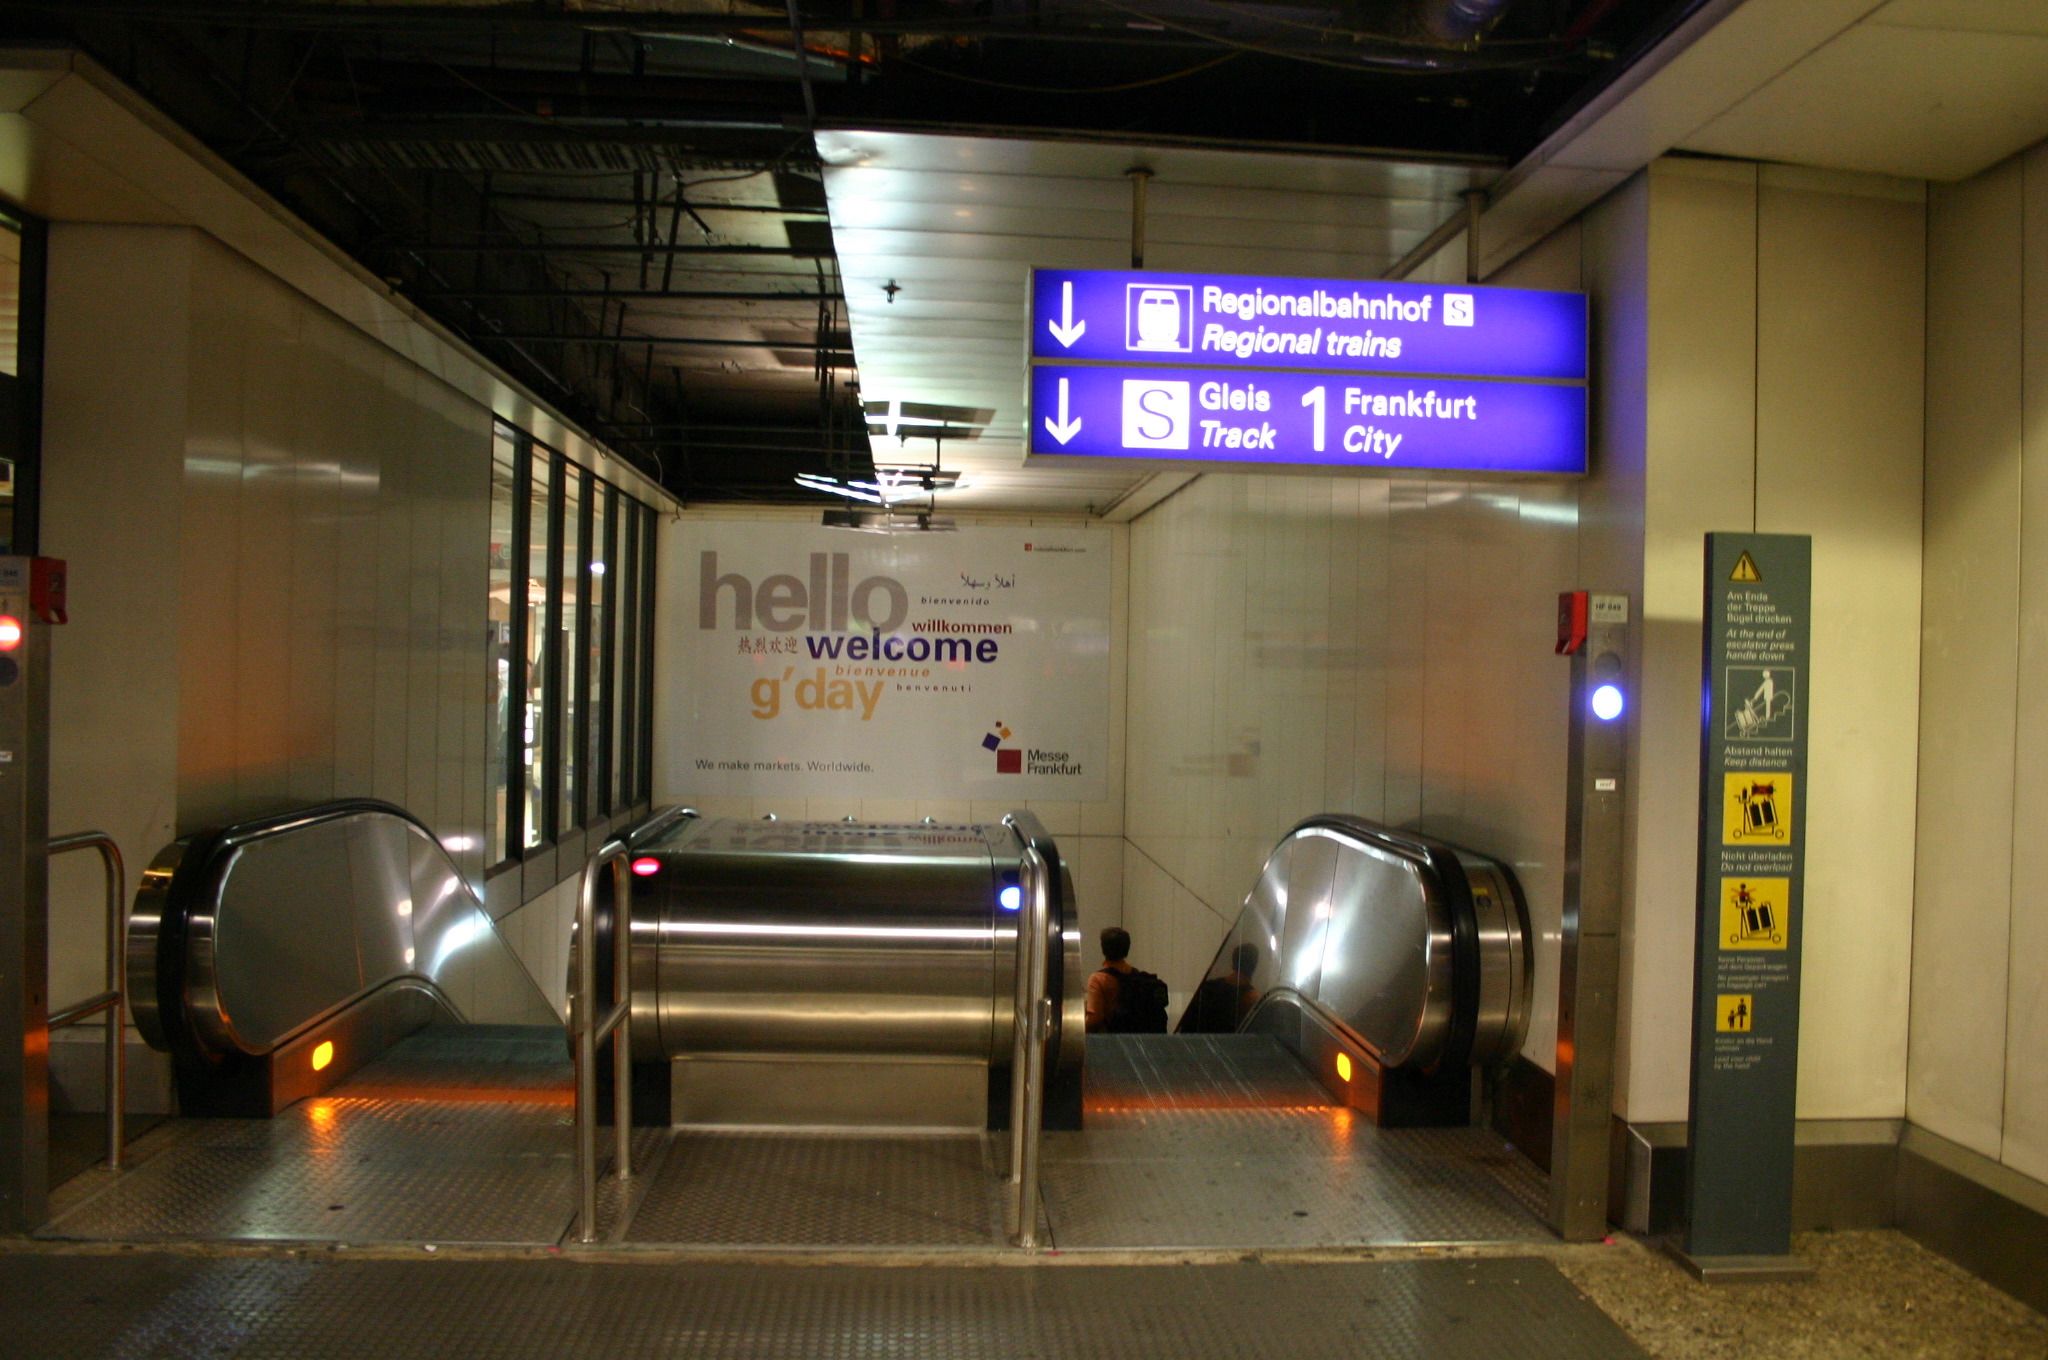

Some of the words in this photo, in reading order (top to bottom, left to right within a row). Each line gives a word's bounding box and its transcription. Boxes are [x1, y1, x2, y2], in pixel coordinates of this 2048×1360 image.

[1202, 285, 1432, 322] Regionalbahnhof
[1201, 323, 1321, 358] Regional
[1327, 331, 1402, 358] trains
[1344, 387, 1477, 419] Frankfurt
[1199, 381, 1271, 411] Gleis
[1301, 385, 1326, 452] 1
[1200, 419, 1277, 450] Track
[1343, 424, 1402, 459] City
[699, 550, 909, 634] hello
[1745, 591, 1768, 602] Ende
[921, 595, 990, 606] bienvenido
[1727, 603, 1741, 612] der
[1745, 602, 1776, 614] Treppe
[912, 619, 1013, 635] willkommen
[1739, 629, 1754, 640] the
[1756, 630, 1774, 640] end
[806, 627, 999, 663] welcome
[1726, 651, 1757, 661] handle
[1759, 651, 1785, 662] down
[836, 664, 931, 678] bienvenue
[896, 682, 972, 693] benvenuti
[1027, 748, 1069, 762] Messe
[1724, 745, 1762, 757] Abstand
[1764, 746, 1793, 757] halten
[695, 759, 715, 771] We
[718, 760, 750, 772] make
[1027, 762, 1082, 776] Frankfurt
[1724, 757, 1747, 768] Keep
[1748, 757, 1788, 768] distance
[1721, 851, 1745, 861] Nicht
[1736, 863, 1752, 872] not
[1753, 862, 1793, 873] overload
